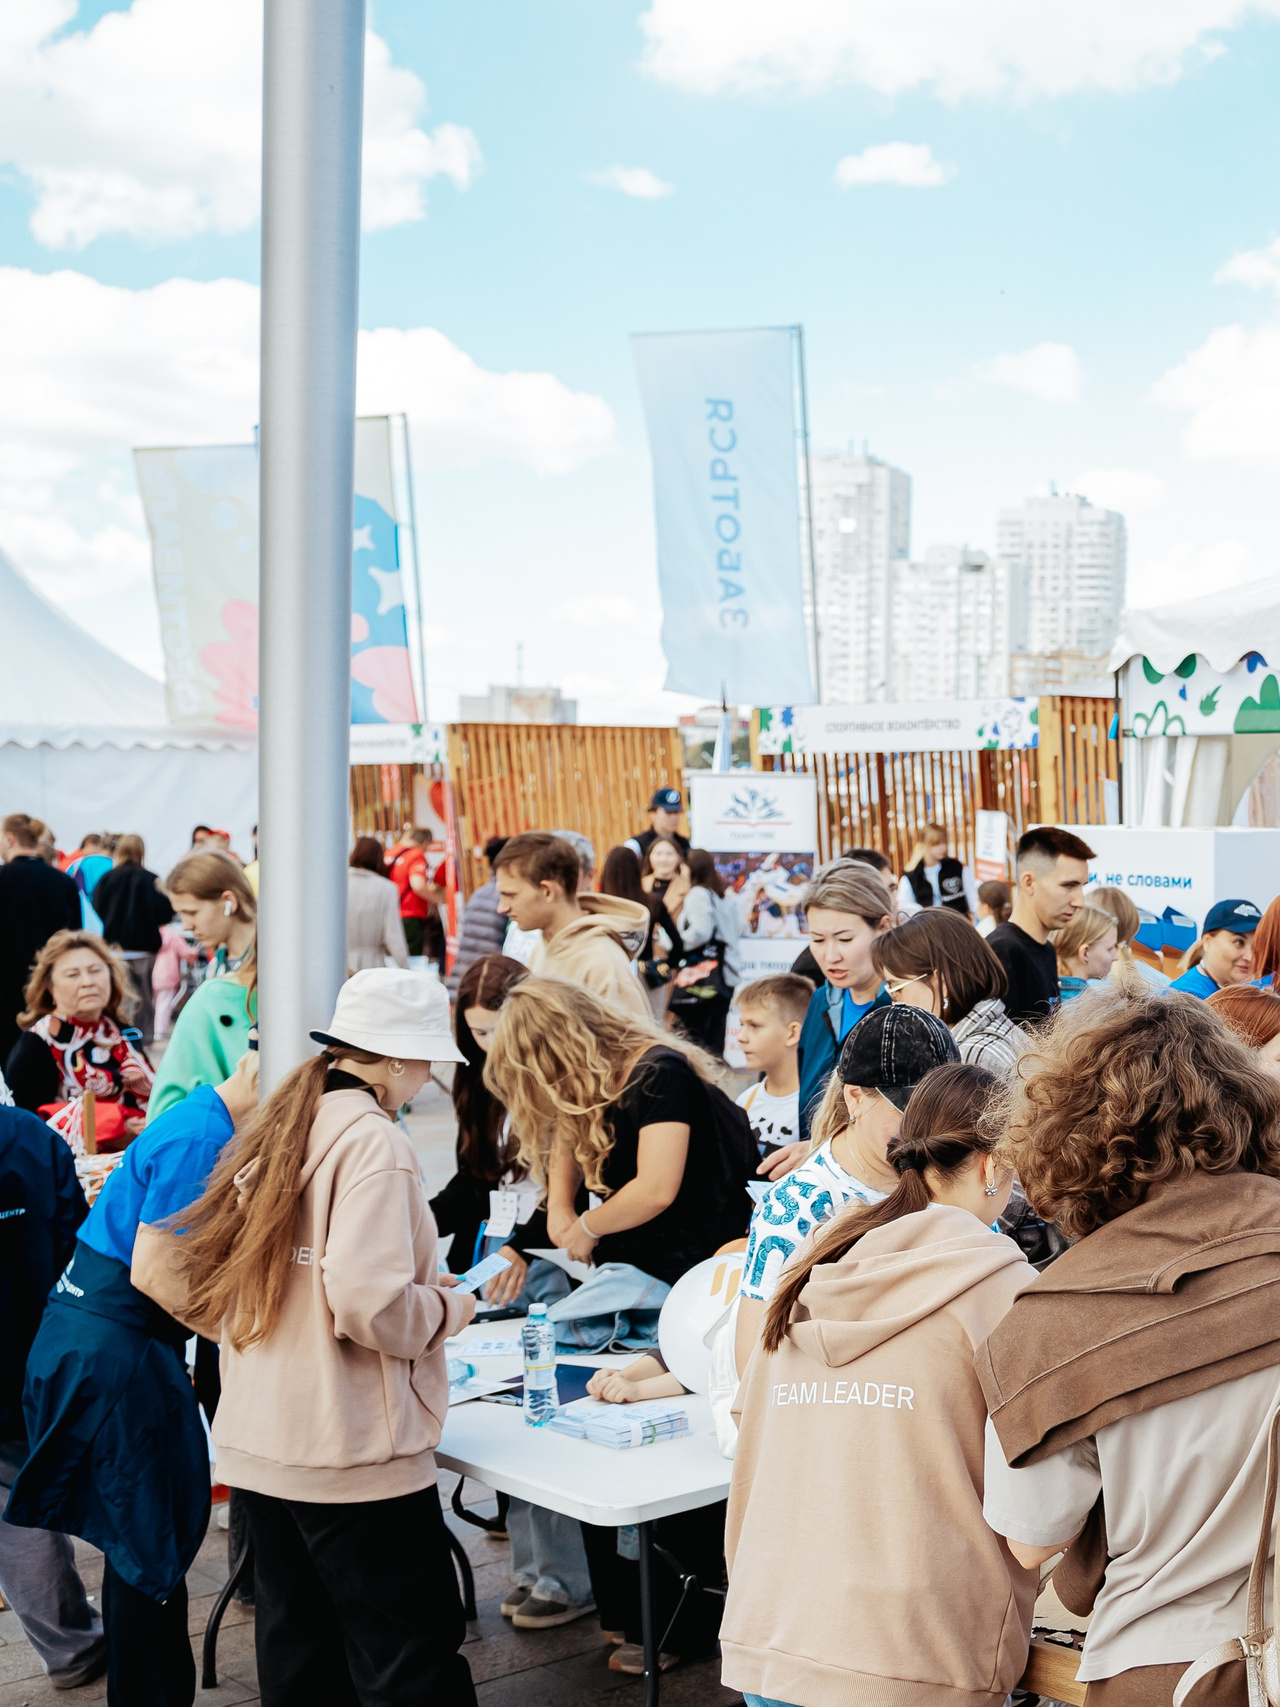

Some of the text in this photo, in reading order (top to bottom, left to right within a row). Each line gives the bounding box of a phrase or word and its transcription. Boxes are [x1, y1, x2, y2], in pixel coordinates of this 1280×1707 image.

[1106, 873, 1123, 885] не
[1127, 874, 1192, 889] словами
[771, 1381, 915, 1411] TEAM LEADER
